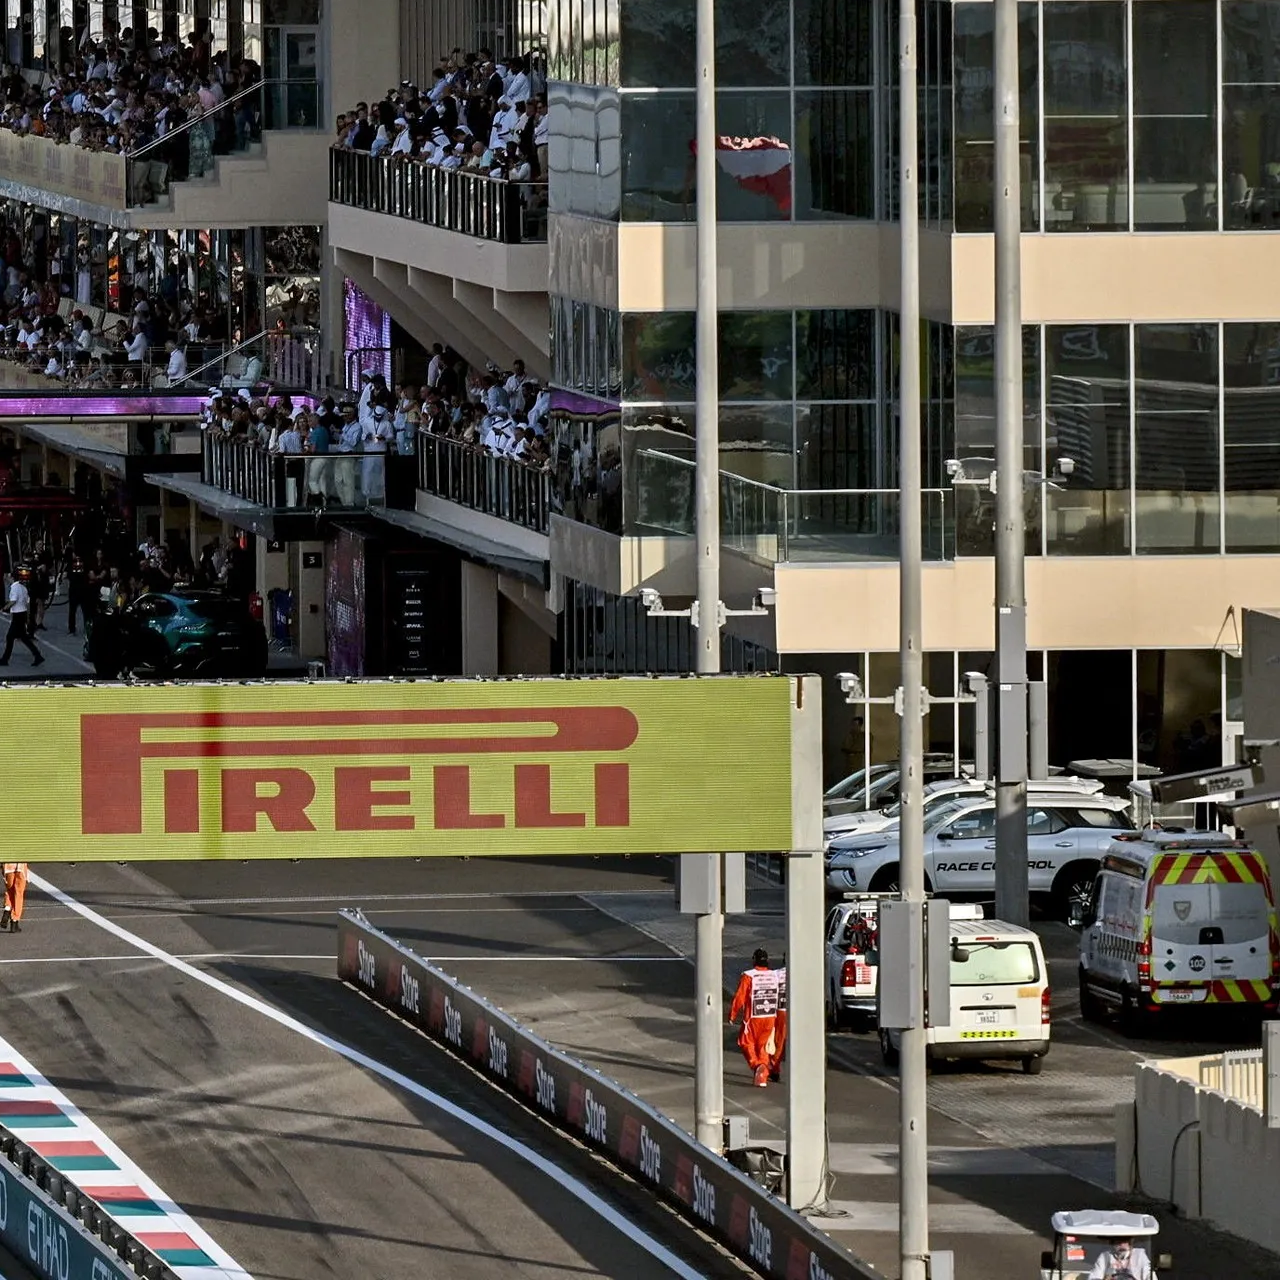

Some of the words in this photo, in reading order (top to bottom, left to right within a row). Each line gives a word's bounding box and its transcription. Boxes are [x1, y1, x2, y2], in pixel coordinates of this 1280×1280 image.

[308, 556, 316, 565] 3
[80, 706, 639, 835] PIRELLI
[936, 862, 979, 872] RACE
[357, 939, 376, 989] Store
[400, 964, 420, 1014] Store
[1189, 958, 1206, 969] 102
[443, 995, 462, 1048] Store
[488, 1025, 508, 1078] Store
[535, 1057, 556, 1115] Store
[584, 1088, 607, 1145] Store
[639, 1124, 661, 1184] Store
[692, 1164, 716, 1226] Store
[27, 1199, 70, 1280] ETIHAD
[748, 1205, 773, 1271] Store
